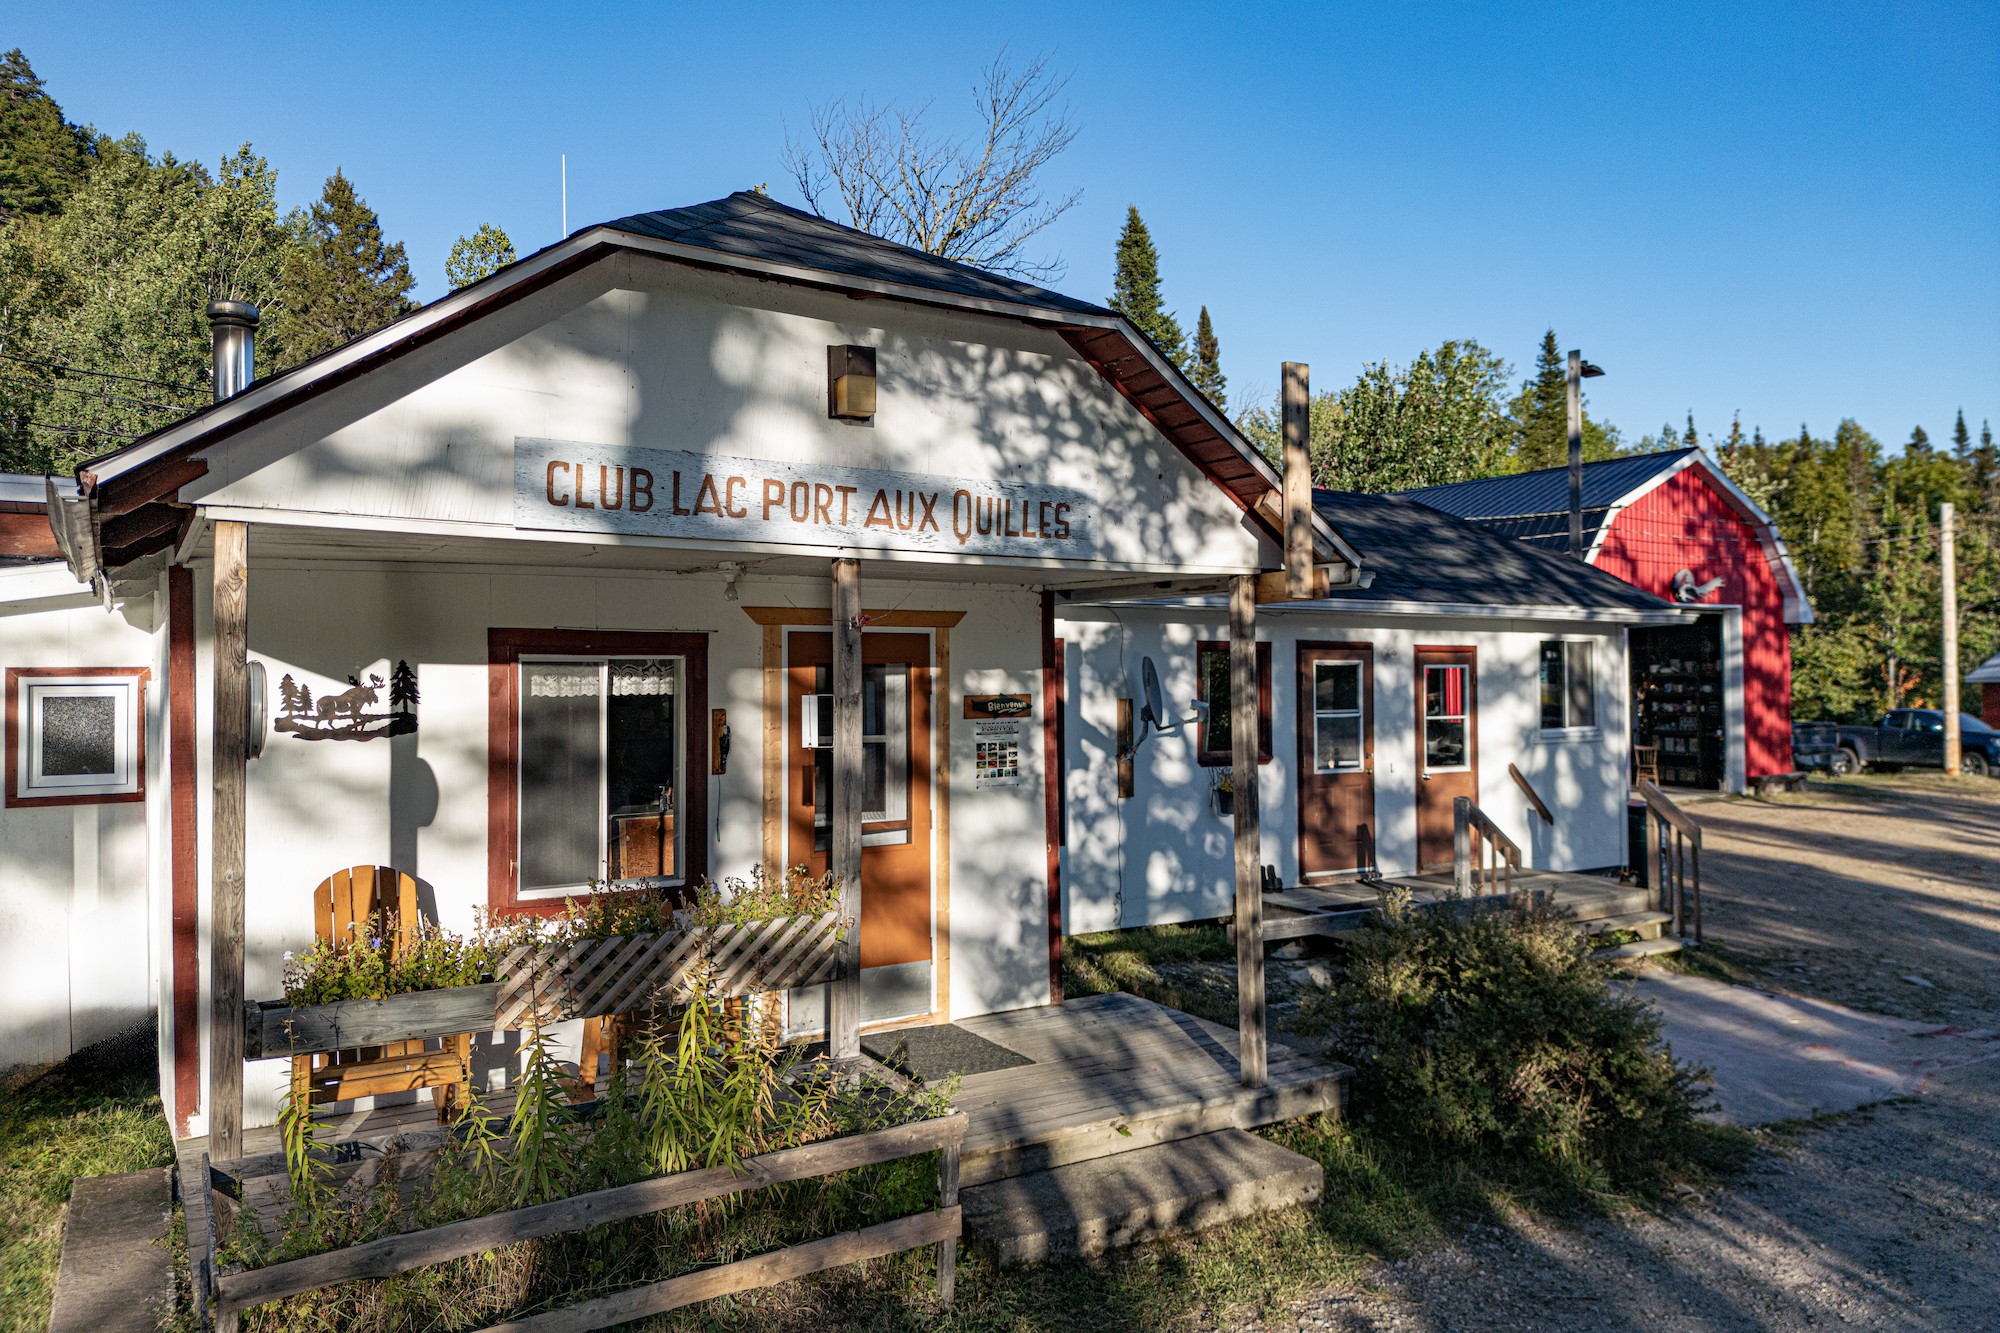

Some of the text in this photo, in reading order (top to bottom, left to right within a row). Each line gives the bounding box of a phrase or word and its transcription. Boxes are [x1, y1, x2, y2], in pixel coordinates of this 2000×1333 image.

[546, 460, 1070, 546] CLUB LAC PORT AUX QUILLES
[987, 702, 1027, 711] Bienvenue
